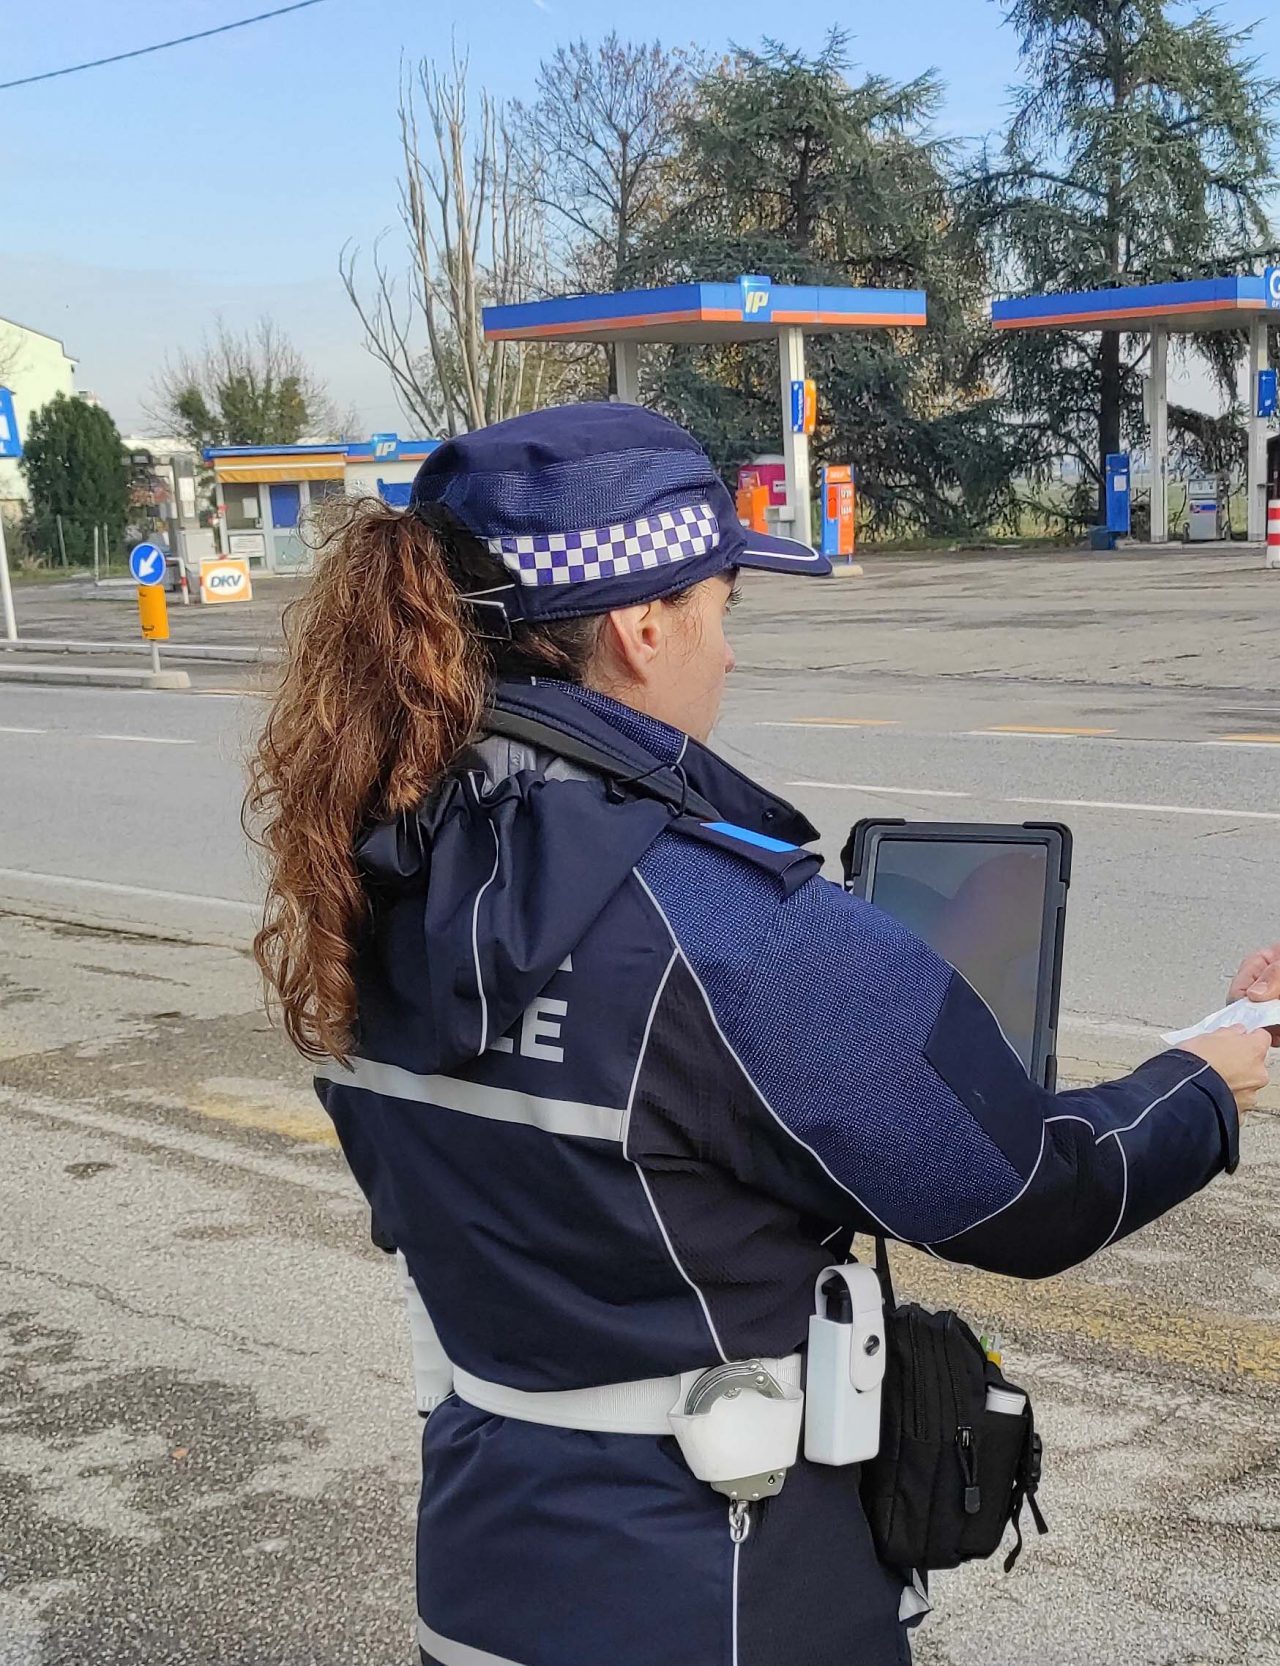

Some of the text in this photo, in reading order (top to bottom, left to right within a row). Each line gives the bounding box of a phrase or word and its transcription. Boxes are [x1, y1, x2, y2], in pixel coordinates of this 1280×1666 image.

[745, 291, 769, 314] IP
[375, 441, 397, 456] IP
[210, 574, 242, 589] DKV
